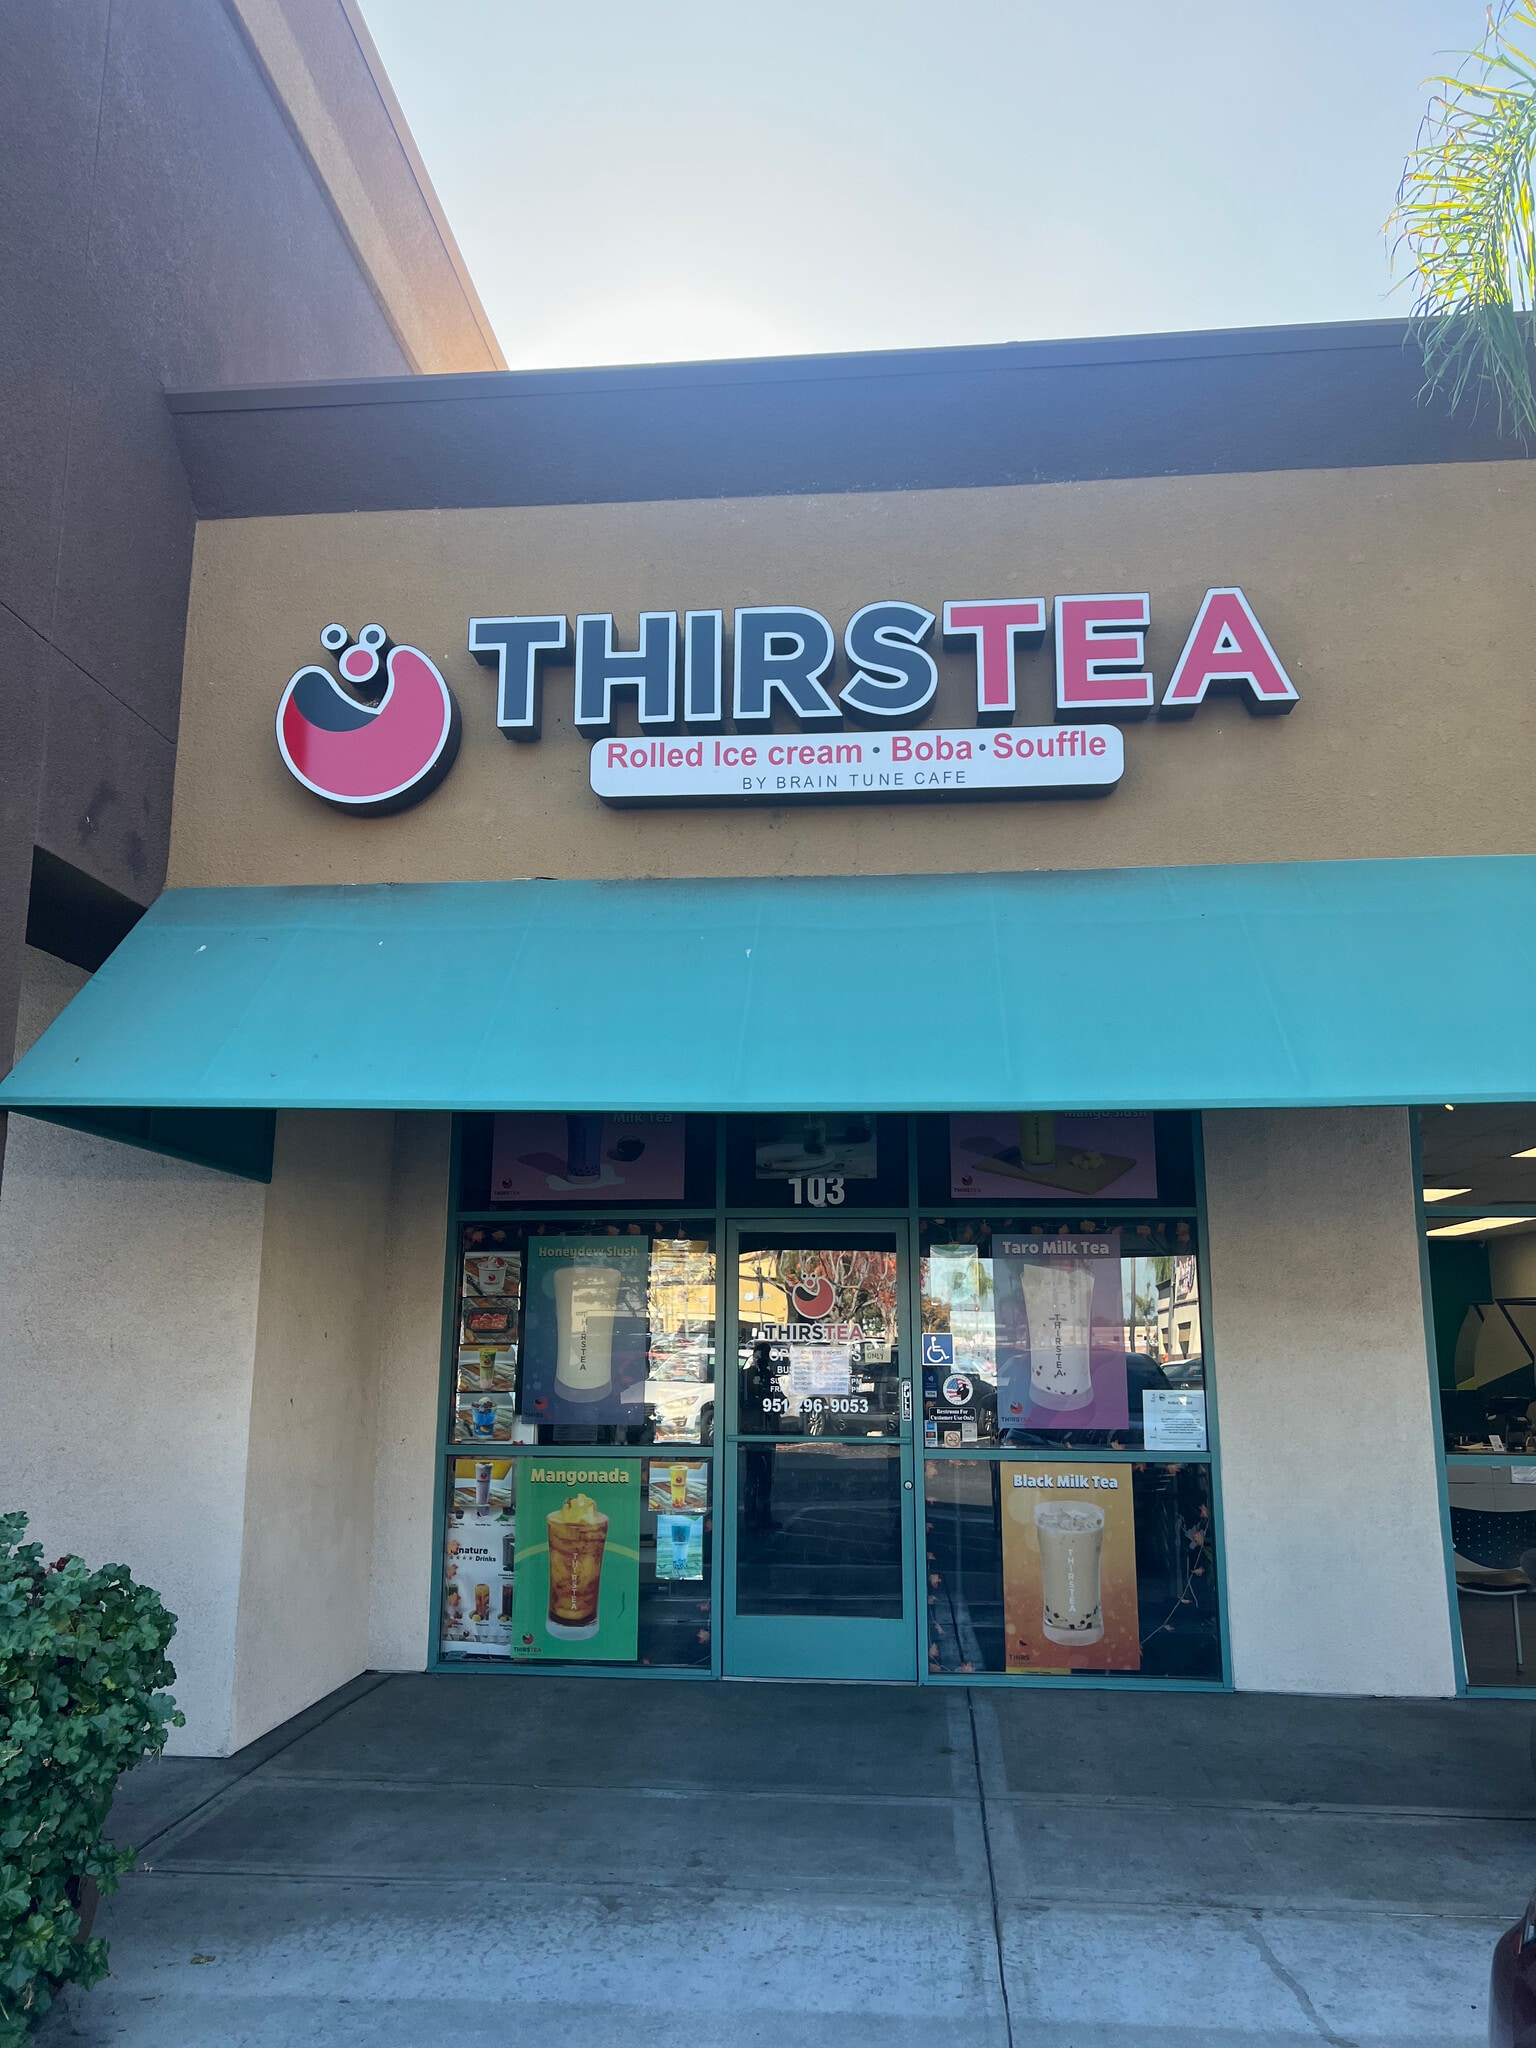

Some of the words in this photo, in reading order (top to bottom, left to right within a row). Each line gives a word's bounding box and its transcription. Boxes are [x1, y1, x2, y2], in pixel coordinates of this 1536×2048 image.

[468, 586, 1300, 735] THIRSTEA
[607, 741, 703, 768] Rolled
[714, 740, 757, 767] Ice
[768, 743, 862, 766] cream
[891, 735, 972, 762] Boba
[993, 731, 1107, 759] Souffle
[742, 776, 766, 790] BY
[776, 774, 837, 789] BRAIN
[849, 772, 904, 787] TUNE
[914, 770, 966, 785] CAFE
[613, 1113, 643, 1123] Milk
[649, 1113, 672, 1123] Tea
[788, 1177, 845, 1206] 103
[539, 1246, 604, 1258] Honeydew
[606, 1245, 638, 1257] Slush
[1002, 1241, 1039, 1254] Taro
[1042, 1240, 1078, 1254] Milk
[1081, 1241, 1109, 1254] Tea
[765, 1324, 864, 1340] THIRSTEA
[1053, 1314, 1063, 1378] THIRSTEA
[867, 1352, 884, 1360] ONLY
[530, 1467, 629, 1486] Mangonada
[1013, 1474, 1054, 1488] Black
[1056, 1474, 1089, 1488] Milk
[1091, 1475, 1118, 1489] Tea
[570, 1552, 578, 1610] THIRSTEA
[1067, 1549, 1076, 1613] THIRSTEA
